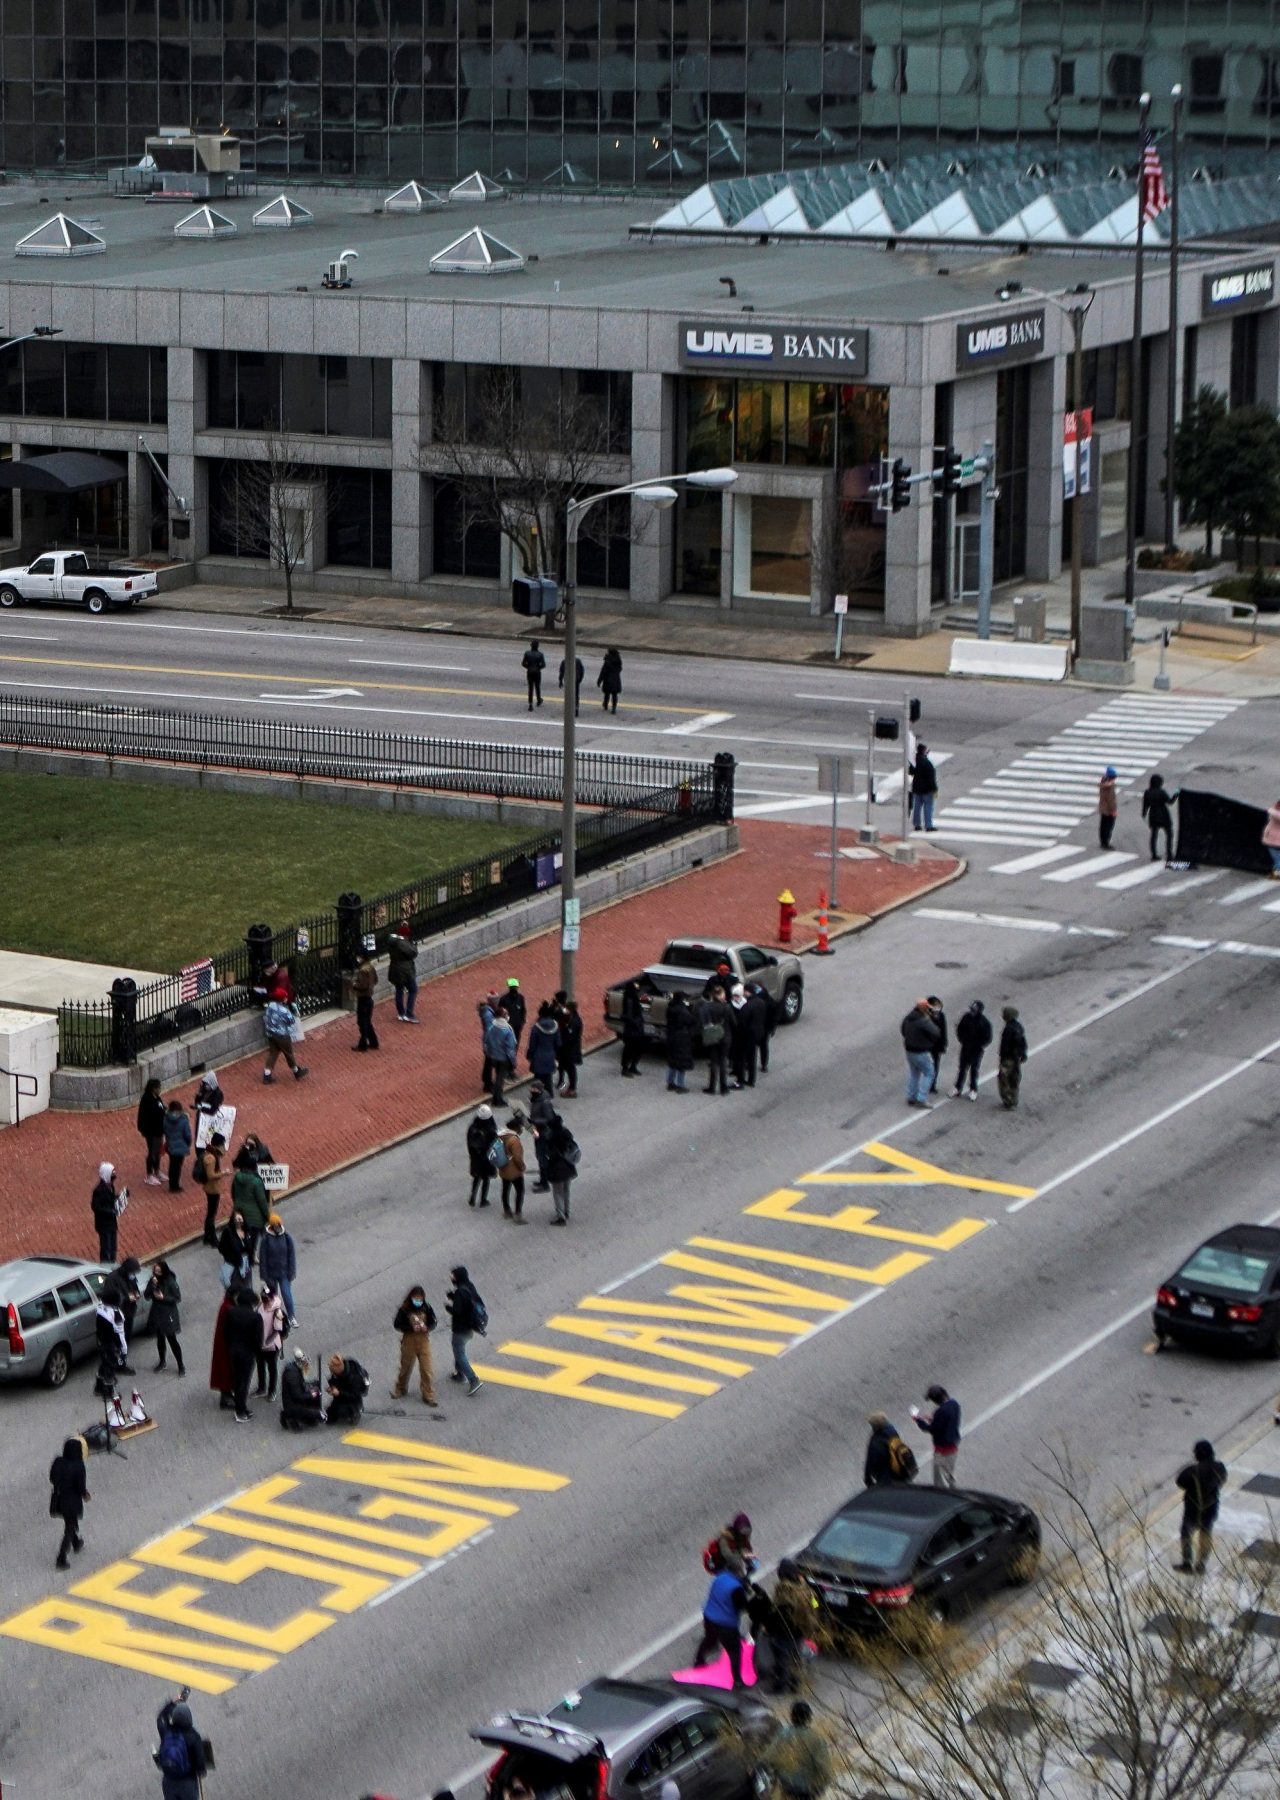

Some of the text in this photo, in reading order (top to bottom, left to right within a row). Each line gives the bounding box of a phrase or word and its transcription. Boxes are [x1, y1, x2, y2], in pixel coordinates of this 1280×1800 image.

[1211, 268, 1273, 302] UMB BANK
[686, 330, 857, 360] UMB BANK
[968, 317, 1042, 354] UMB BANK
[260, 1168, 284, 1177] RESIGN
[473, 1142, 1037, 1418] HAWLEY
